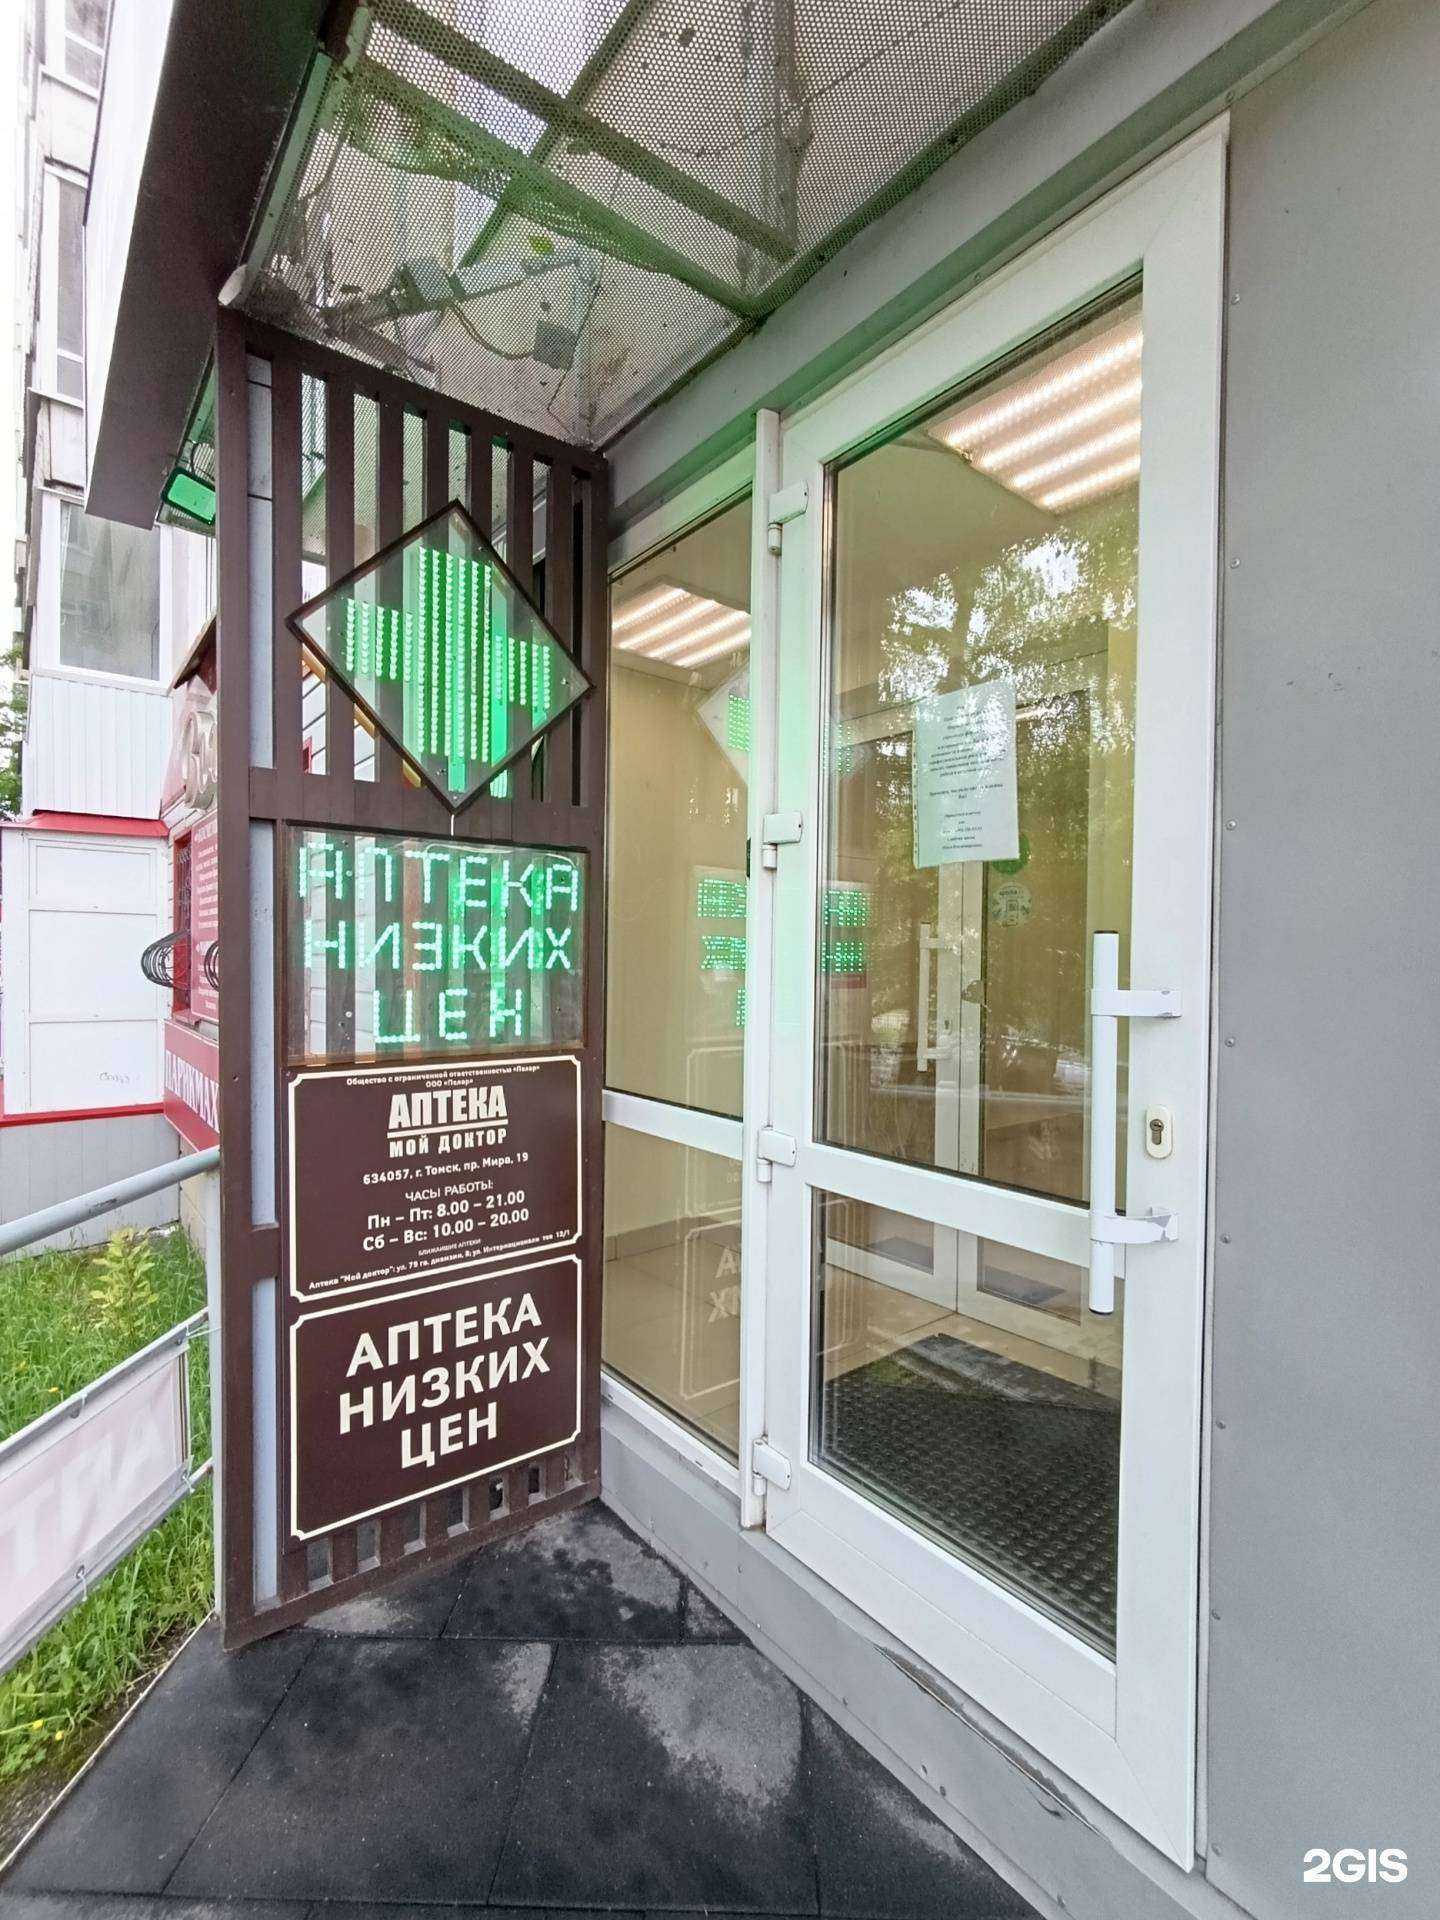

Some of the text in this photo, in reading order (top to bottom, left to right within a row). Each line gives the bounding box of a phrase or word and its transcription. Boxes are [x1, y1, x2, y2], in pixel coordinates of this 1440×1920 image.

[299, 842, 578, 911] АПТЕКА
[304, 920, 571, 970] НИЗКИХ
[374, 989, 521, 1043] ЦЕН
[346, 1076, 387, 1087] Общество
[394, 1071, 448, 1083] ограниченной
[426, 1080, 443, 1088] ООО
[388, 1085, 508, 1130] АПТЕКА
[389, 1128, 508, 1159] МОЙ ДОКТОР
[363, 1152, 529, 1185] 634057, г. Томск, пр. Мира, 19
[367, 1214, 390, 1230] Пн
[410, 1208, 432, 1223] Пт:
[437, 1199, 469, 1218] 8.00
[486, 1190, 525, 1210] 21.00
[405, 1179, 494, 1203] ЧАСЫ РАБОТЫ:
[362, 1233, 385, 1252] Сб
[404, 1228, 428, 1245] Вс:
[432, 1218, 474, 1239] 10.00
[490, 1209, 530, 1228] 20.00
[309, 1277, 339, 1290] Аптека
[346, 1293, 542, 1377] АПТЕКА
[340, 1337, 550, 1434] НИЗКИХ
[401, 1402, 497, 1469] ЦЕН
